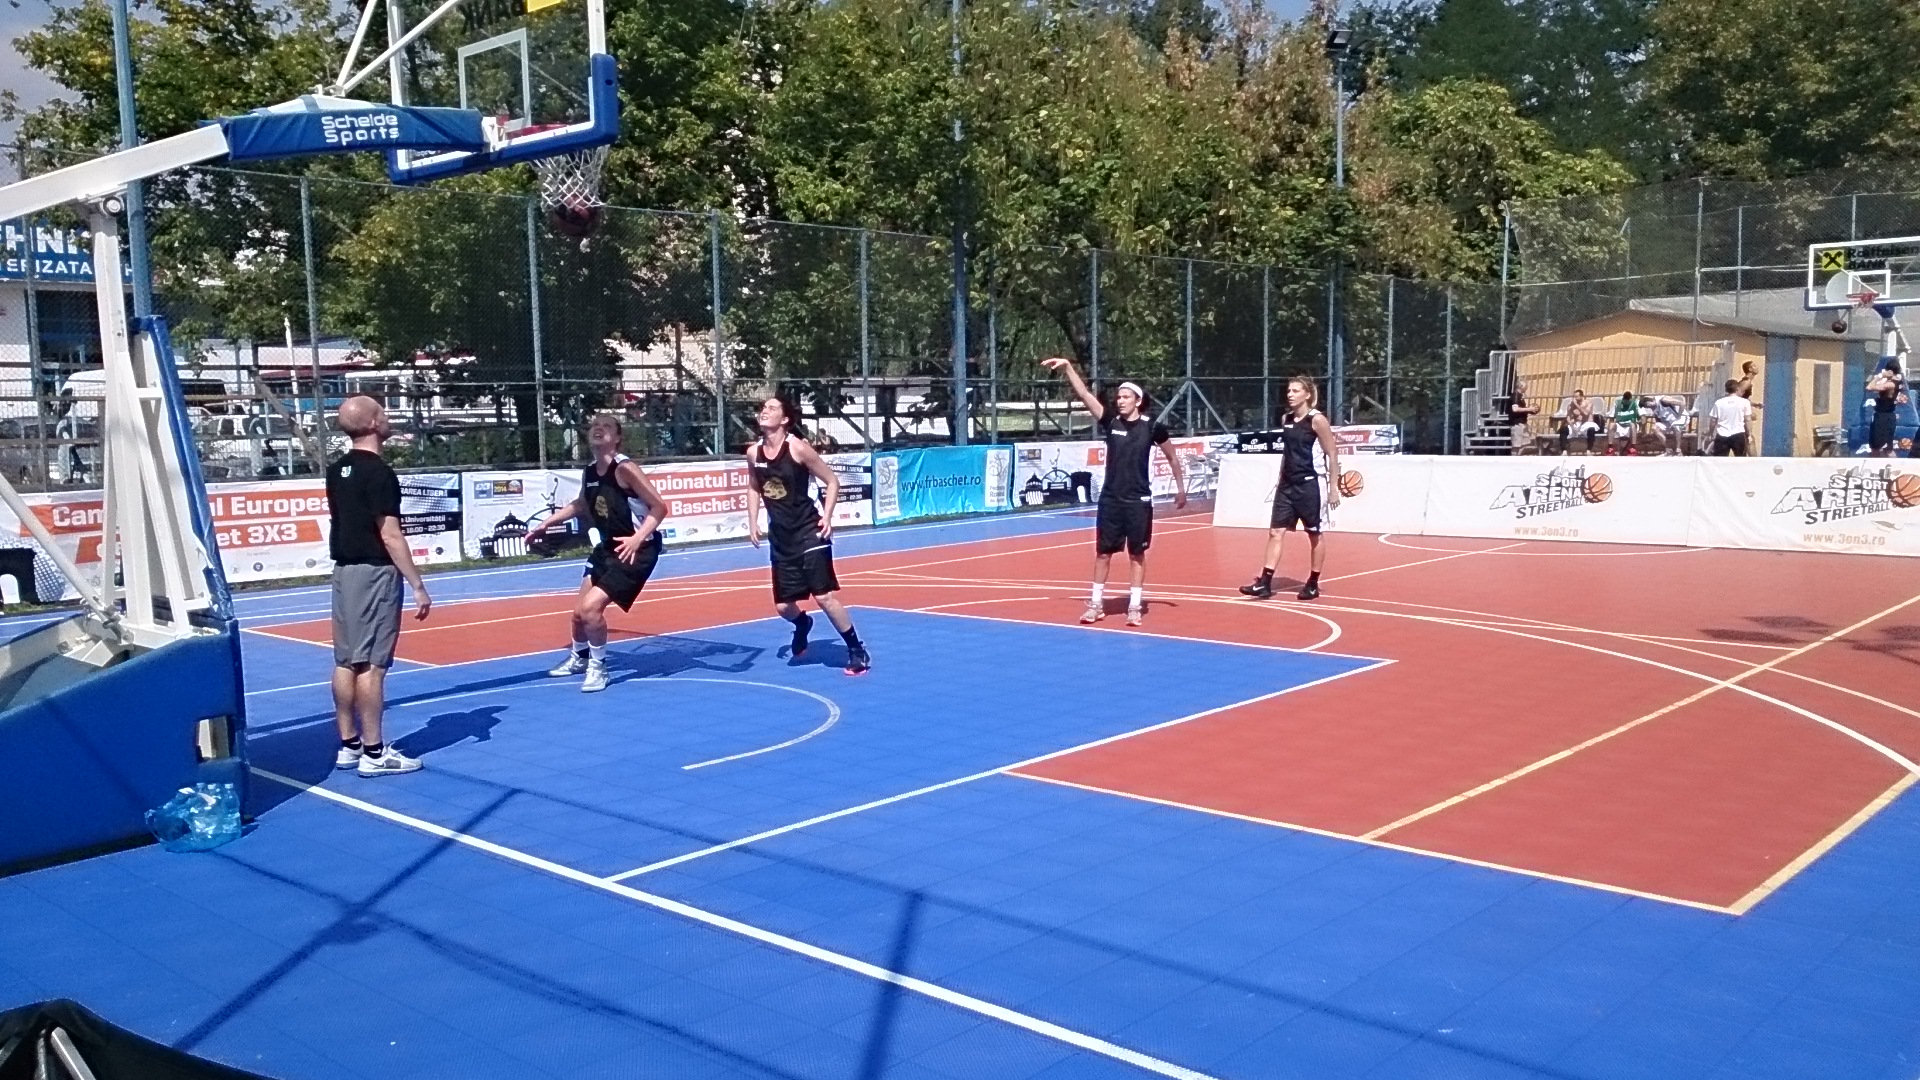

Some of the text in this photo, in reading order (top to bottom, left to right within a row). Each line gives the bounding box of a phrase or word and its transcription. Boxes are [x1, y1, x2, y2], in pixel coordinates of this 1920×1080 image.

[321, 113, 398, 129] Schelde
[324, 126, 400, 146] Sports
[0, 258, 93, 275] ERIZATA
[650, 472, 727, 493] pionatul
[901, 474, 981, 492] www.frbaschet.ro
[1537, 473, 1582, 488] SPORT
[1829, 474, 1888, 489] SPORT
[231, 495, 330, 517] Europea
[671, 497, 737, 516] Baschet
[1489, 484, 1583, 510] ARENA
[1771, 486, 1889, 514] ARENA
[1515, 498, 1583, 519] STREETBALL
[1805, 501, 1889, 525] STREETBALL
[247, 523, 298, 544] 3X3
[1514, 526, 1579, 538] www.3on3.ro
[1803, 533, 1886, 546] www.3on3.ro
